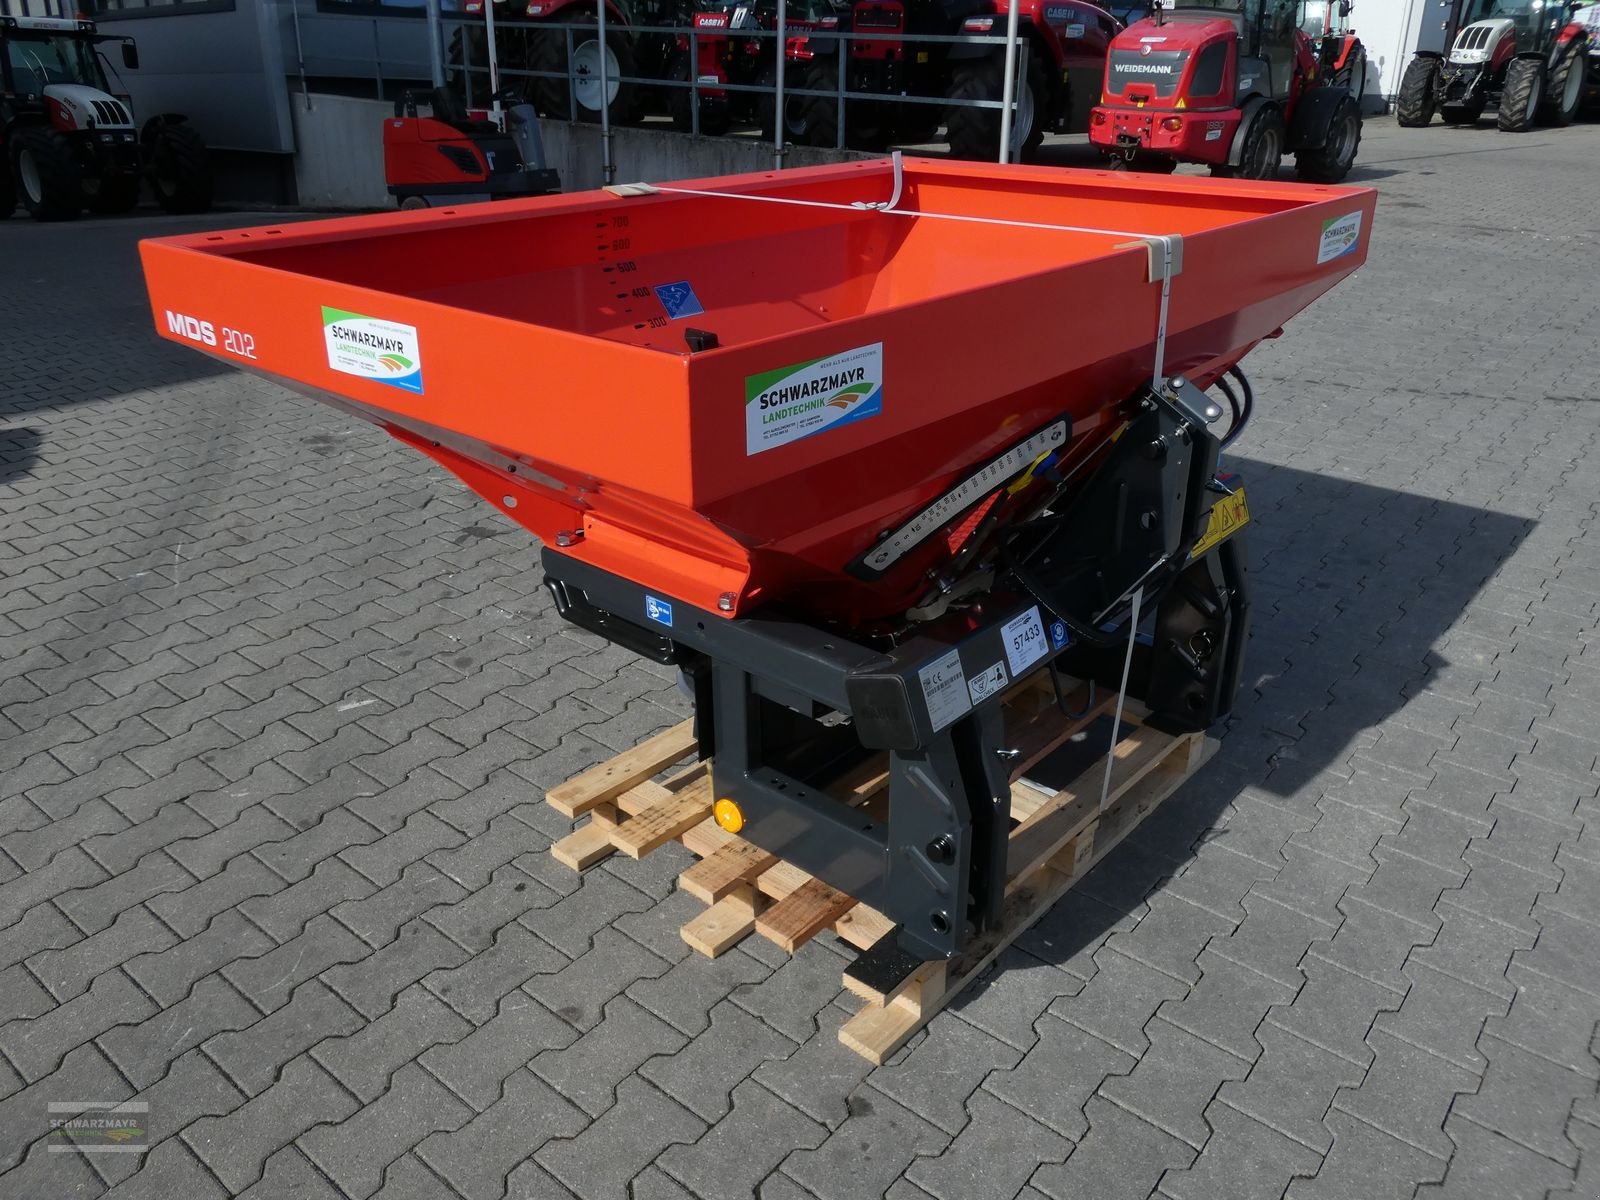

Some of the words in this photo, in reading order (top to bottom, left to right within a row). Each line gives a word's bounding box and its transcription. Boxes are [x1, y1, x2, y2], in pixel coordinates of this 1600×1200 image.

[1115, 64, 1171, 73] WEIDEMANN
[612, 216, 629, 228] 700
[612, 238, 630, 250] 600
[617, 262, 637, 273] 500
[632, 287, 650, 298] 400
[647, 316, 667, 328] 300
[166, 310, 217, 346] MDS
[222, 327, 257, 360] 20.2
[332, 325, 404, 354] SCHWARZMAYR
[336, 342, 377, 360] LANDTECHNIK
[760, 367, 865, 410] SCHWARZMAYR
[762, 398, 826, 424] LANDTECHNIK
[1013, 624, 1040, 650] 57433
